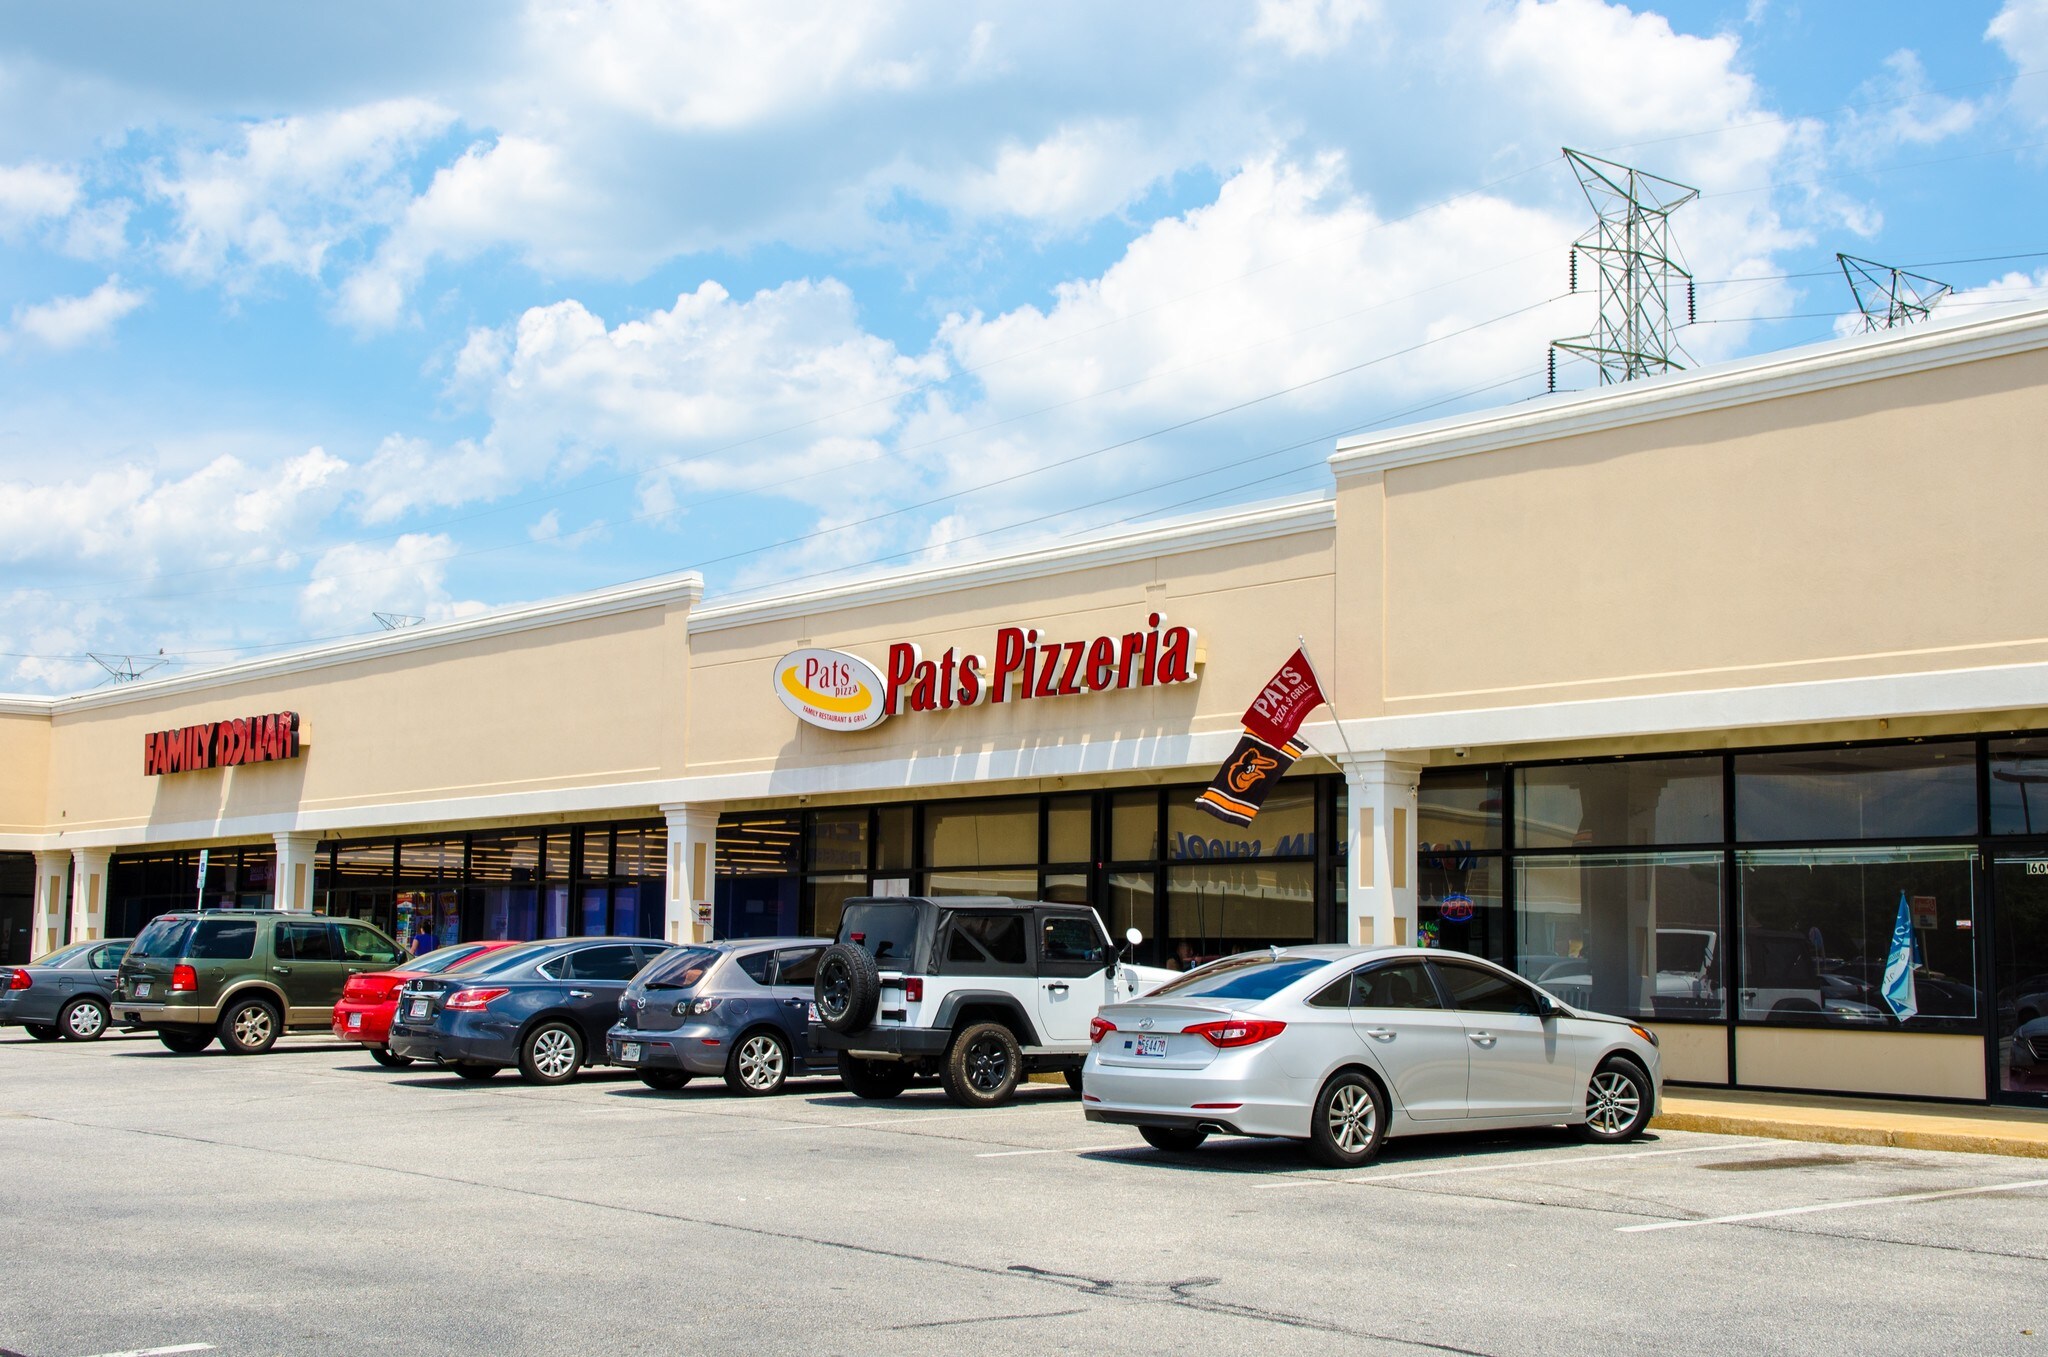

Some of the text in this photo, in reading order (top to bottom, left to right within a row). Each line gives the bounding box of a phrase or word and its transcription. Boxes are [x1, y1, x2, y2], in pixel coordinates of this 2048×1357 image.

[805, 658, 849, 689] Pats
[885, 612, 1193, 715] Pats Pizzeria
[835, 684, 858, 698] pizza
[1252, 666, 1302, 719] PATS
[1270, 703, 1289, 727] PIZZA
[1290, 681, 1312, 700] GRILL
[803, 706, 818, 717] FAMILY
[819, 712, 847, 723] RESTAURANT
[853, 713, 868, 723] GRILL
[144, 711, 296, 776] FAMILY DOLLAR
[2027, 863, 2048, 874] 160
[1441, 900, 1473, 916] OPEN
